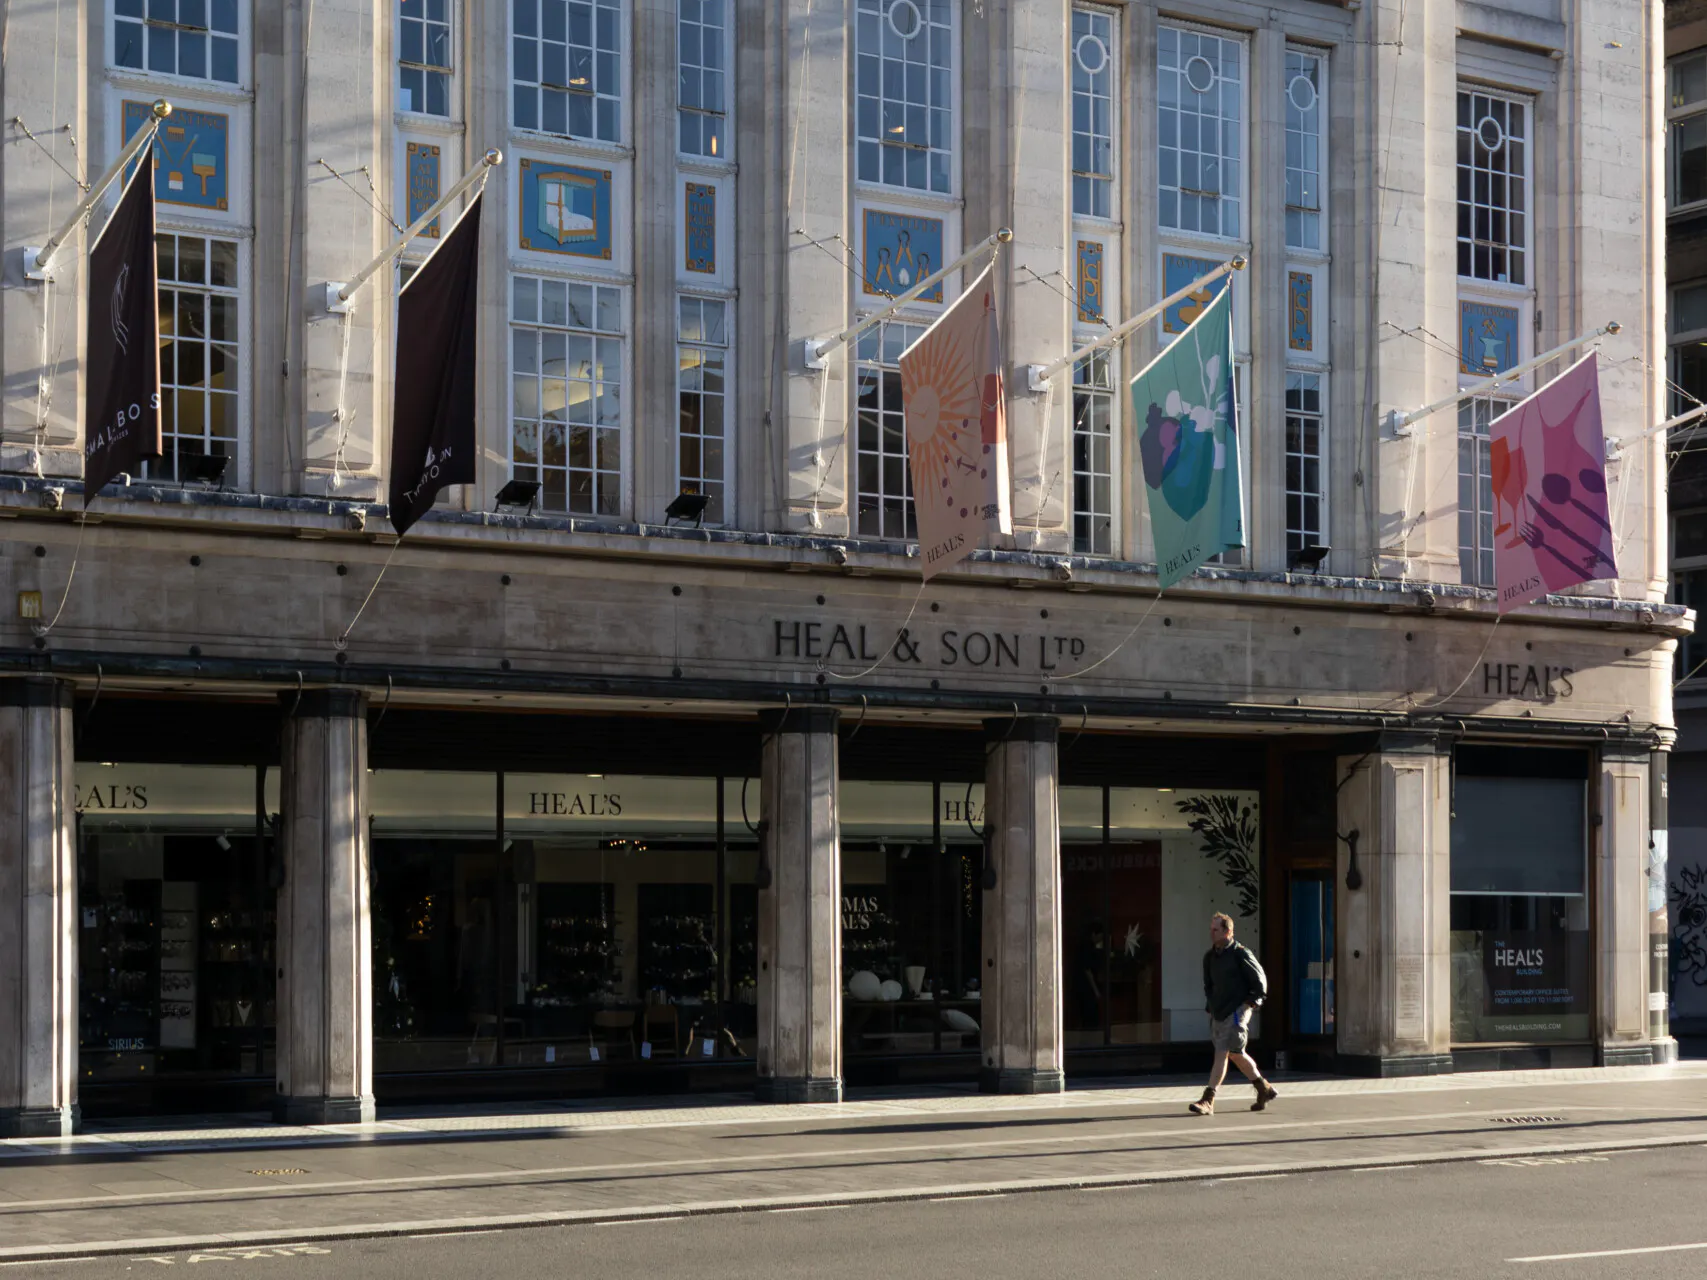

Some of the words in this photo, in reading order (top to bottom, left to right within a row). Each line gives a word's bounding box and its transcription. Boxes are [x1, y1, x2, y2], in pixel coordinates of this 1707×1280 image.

[926, 533, 965, 564] HEAL'S
[1164, 543, 1201, 575] HEAL'S
[1502, 575, 1541, 601] HEAL'S
[774, 620, 878, 662] HEAL
[892, 626, 922, 664] &
[940, 629, 1020, 668] SON
[1482, 662, 1574, 698] HEAL'S
[528, 791, 622, 817] HEAL'S
[841, 896, 878, 913] MAS
[1494, 948, 1544, 967] HEAL'S
[108, 1037, 145, 1051] SIRIUS
